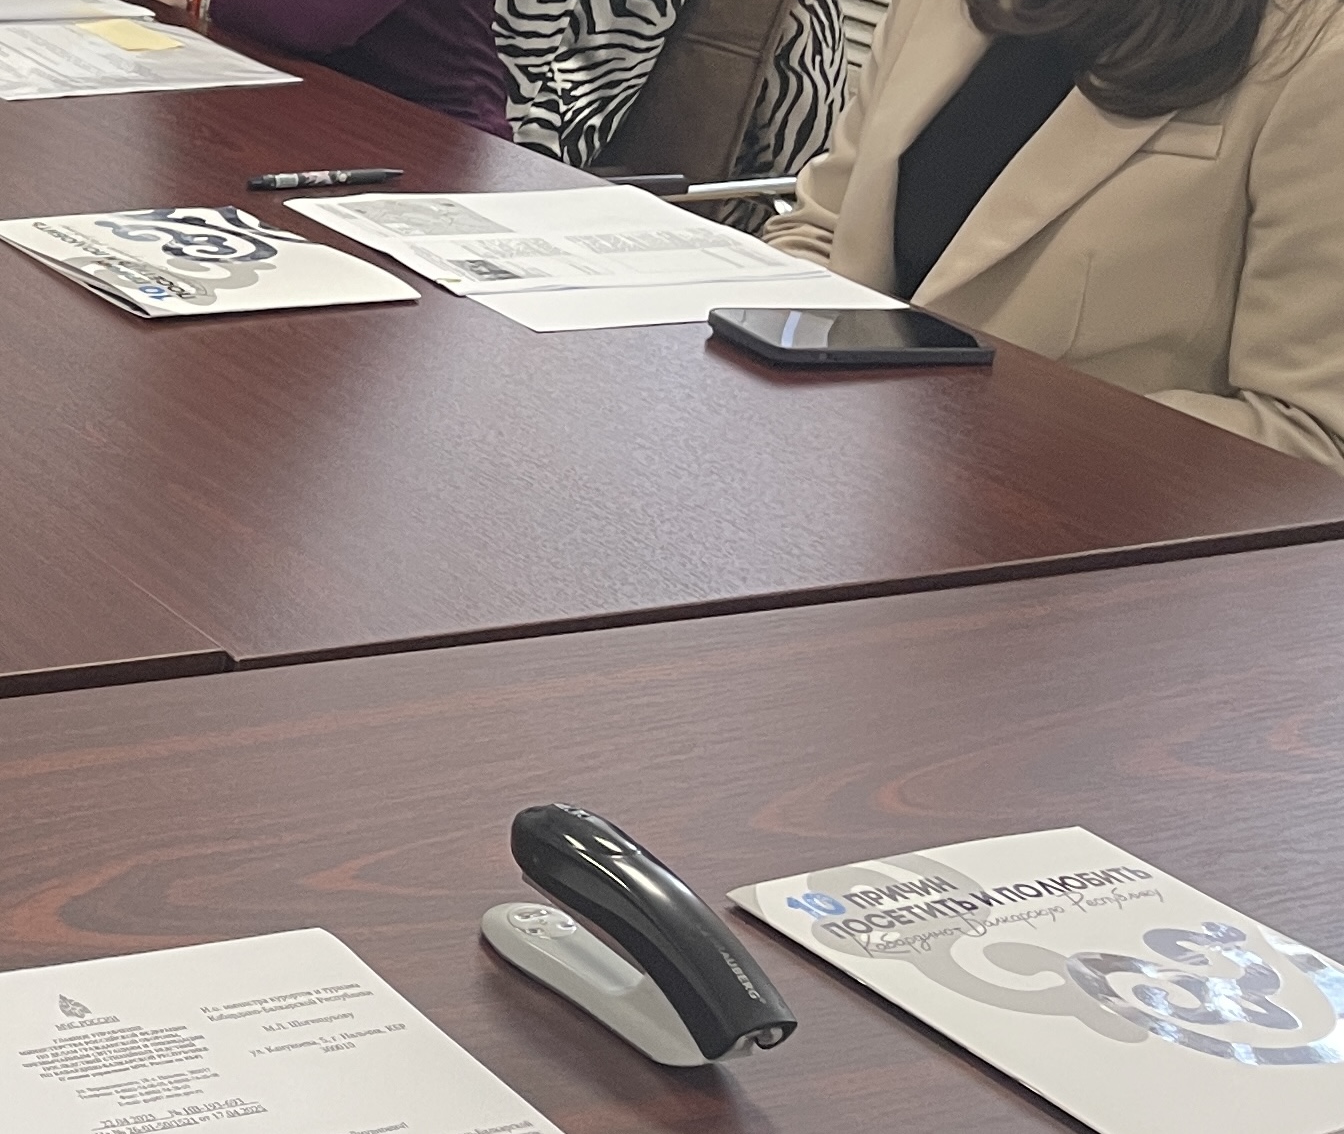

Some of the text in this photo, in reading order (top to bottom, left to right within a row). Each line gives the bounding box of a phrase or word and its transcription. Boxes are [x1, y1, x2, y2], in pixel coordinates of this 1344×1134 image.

[786, 876, 959, 921] 10 ПРИЧИН
[821, 866, 1153, 940] ПОСЕТИТЬ И ПОЛЮБИТЬ
